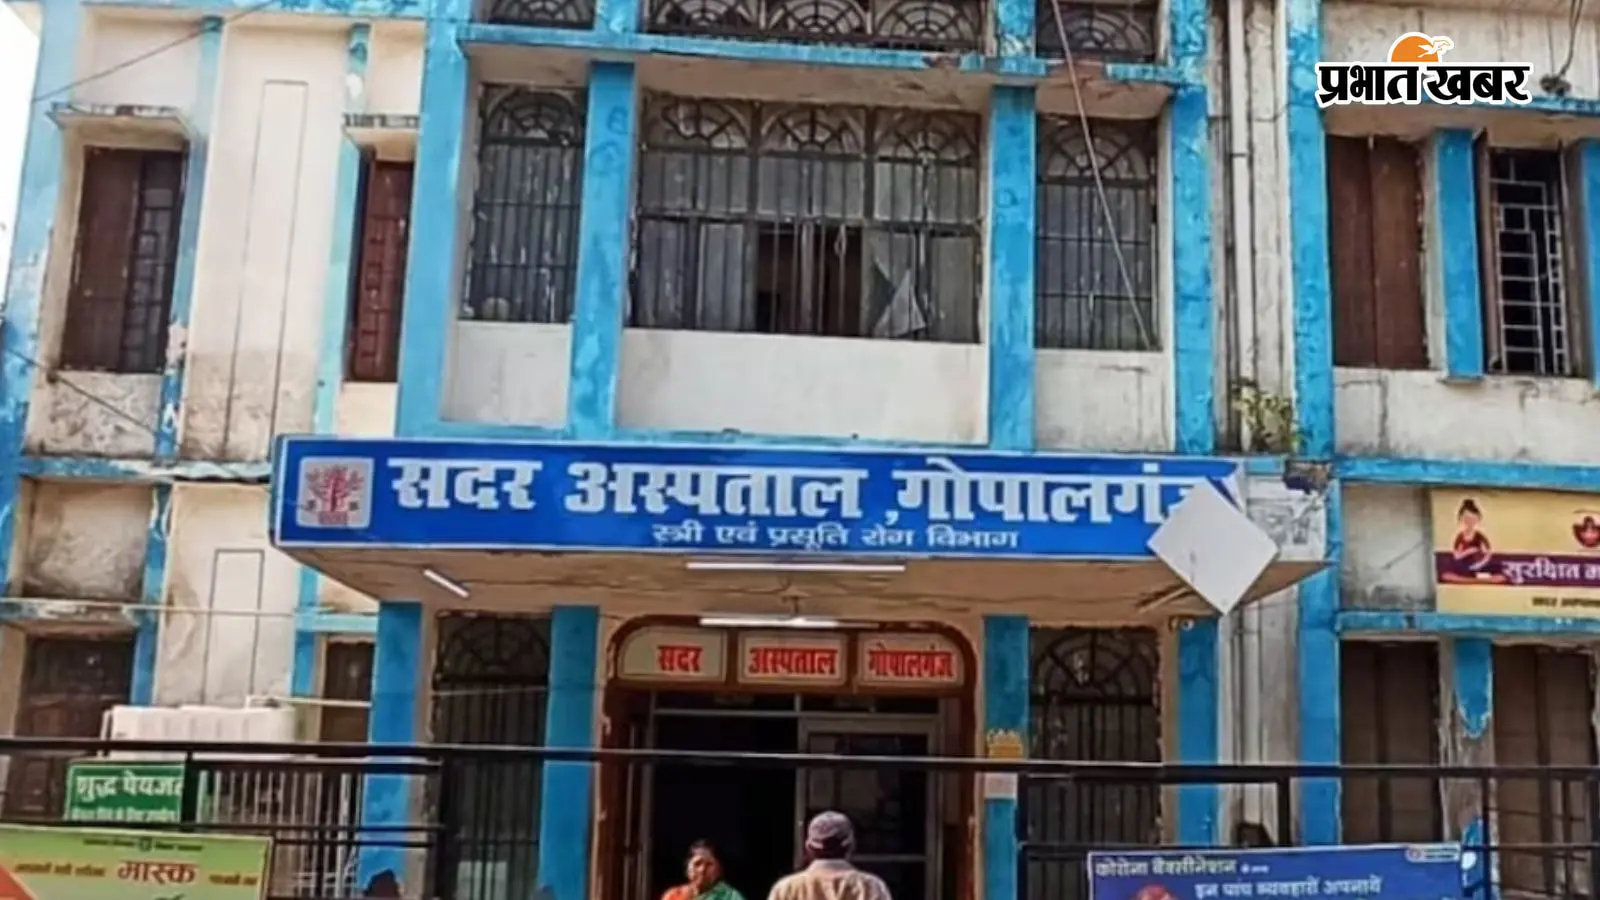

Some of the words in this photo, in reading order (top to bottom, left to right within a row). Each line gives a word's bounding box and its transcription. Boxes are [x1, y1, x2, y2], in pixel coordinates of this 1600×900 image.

[386, 457, 542, 510] सदर
[564, 461, 868, 519] अस्पताल
[651, 518, 704, 547] स्त्री
[714, 520, 758, 545] एवं
[766, 521, 850, 551] प्रसूति
[860, 523, 915, 547] रोग
[926, 523, 1019, 549] विभाग
[657, 644, 703, 673] सदर
[748, 647, 839, 676] अस्पताल
[867, 641, 955, 678] गोपालगंज
[117, 860, 196, 884] मास्क
